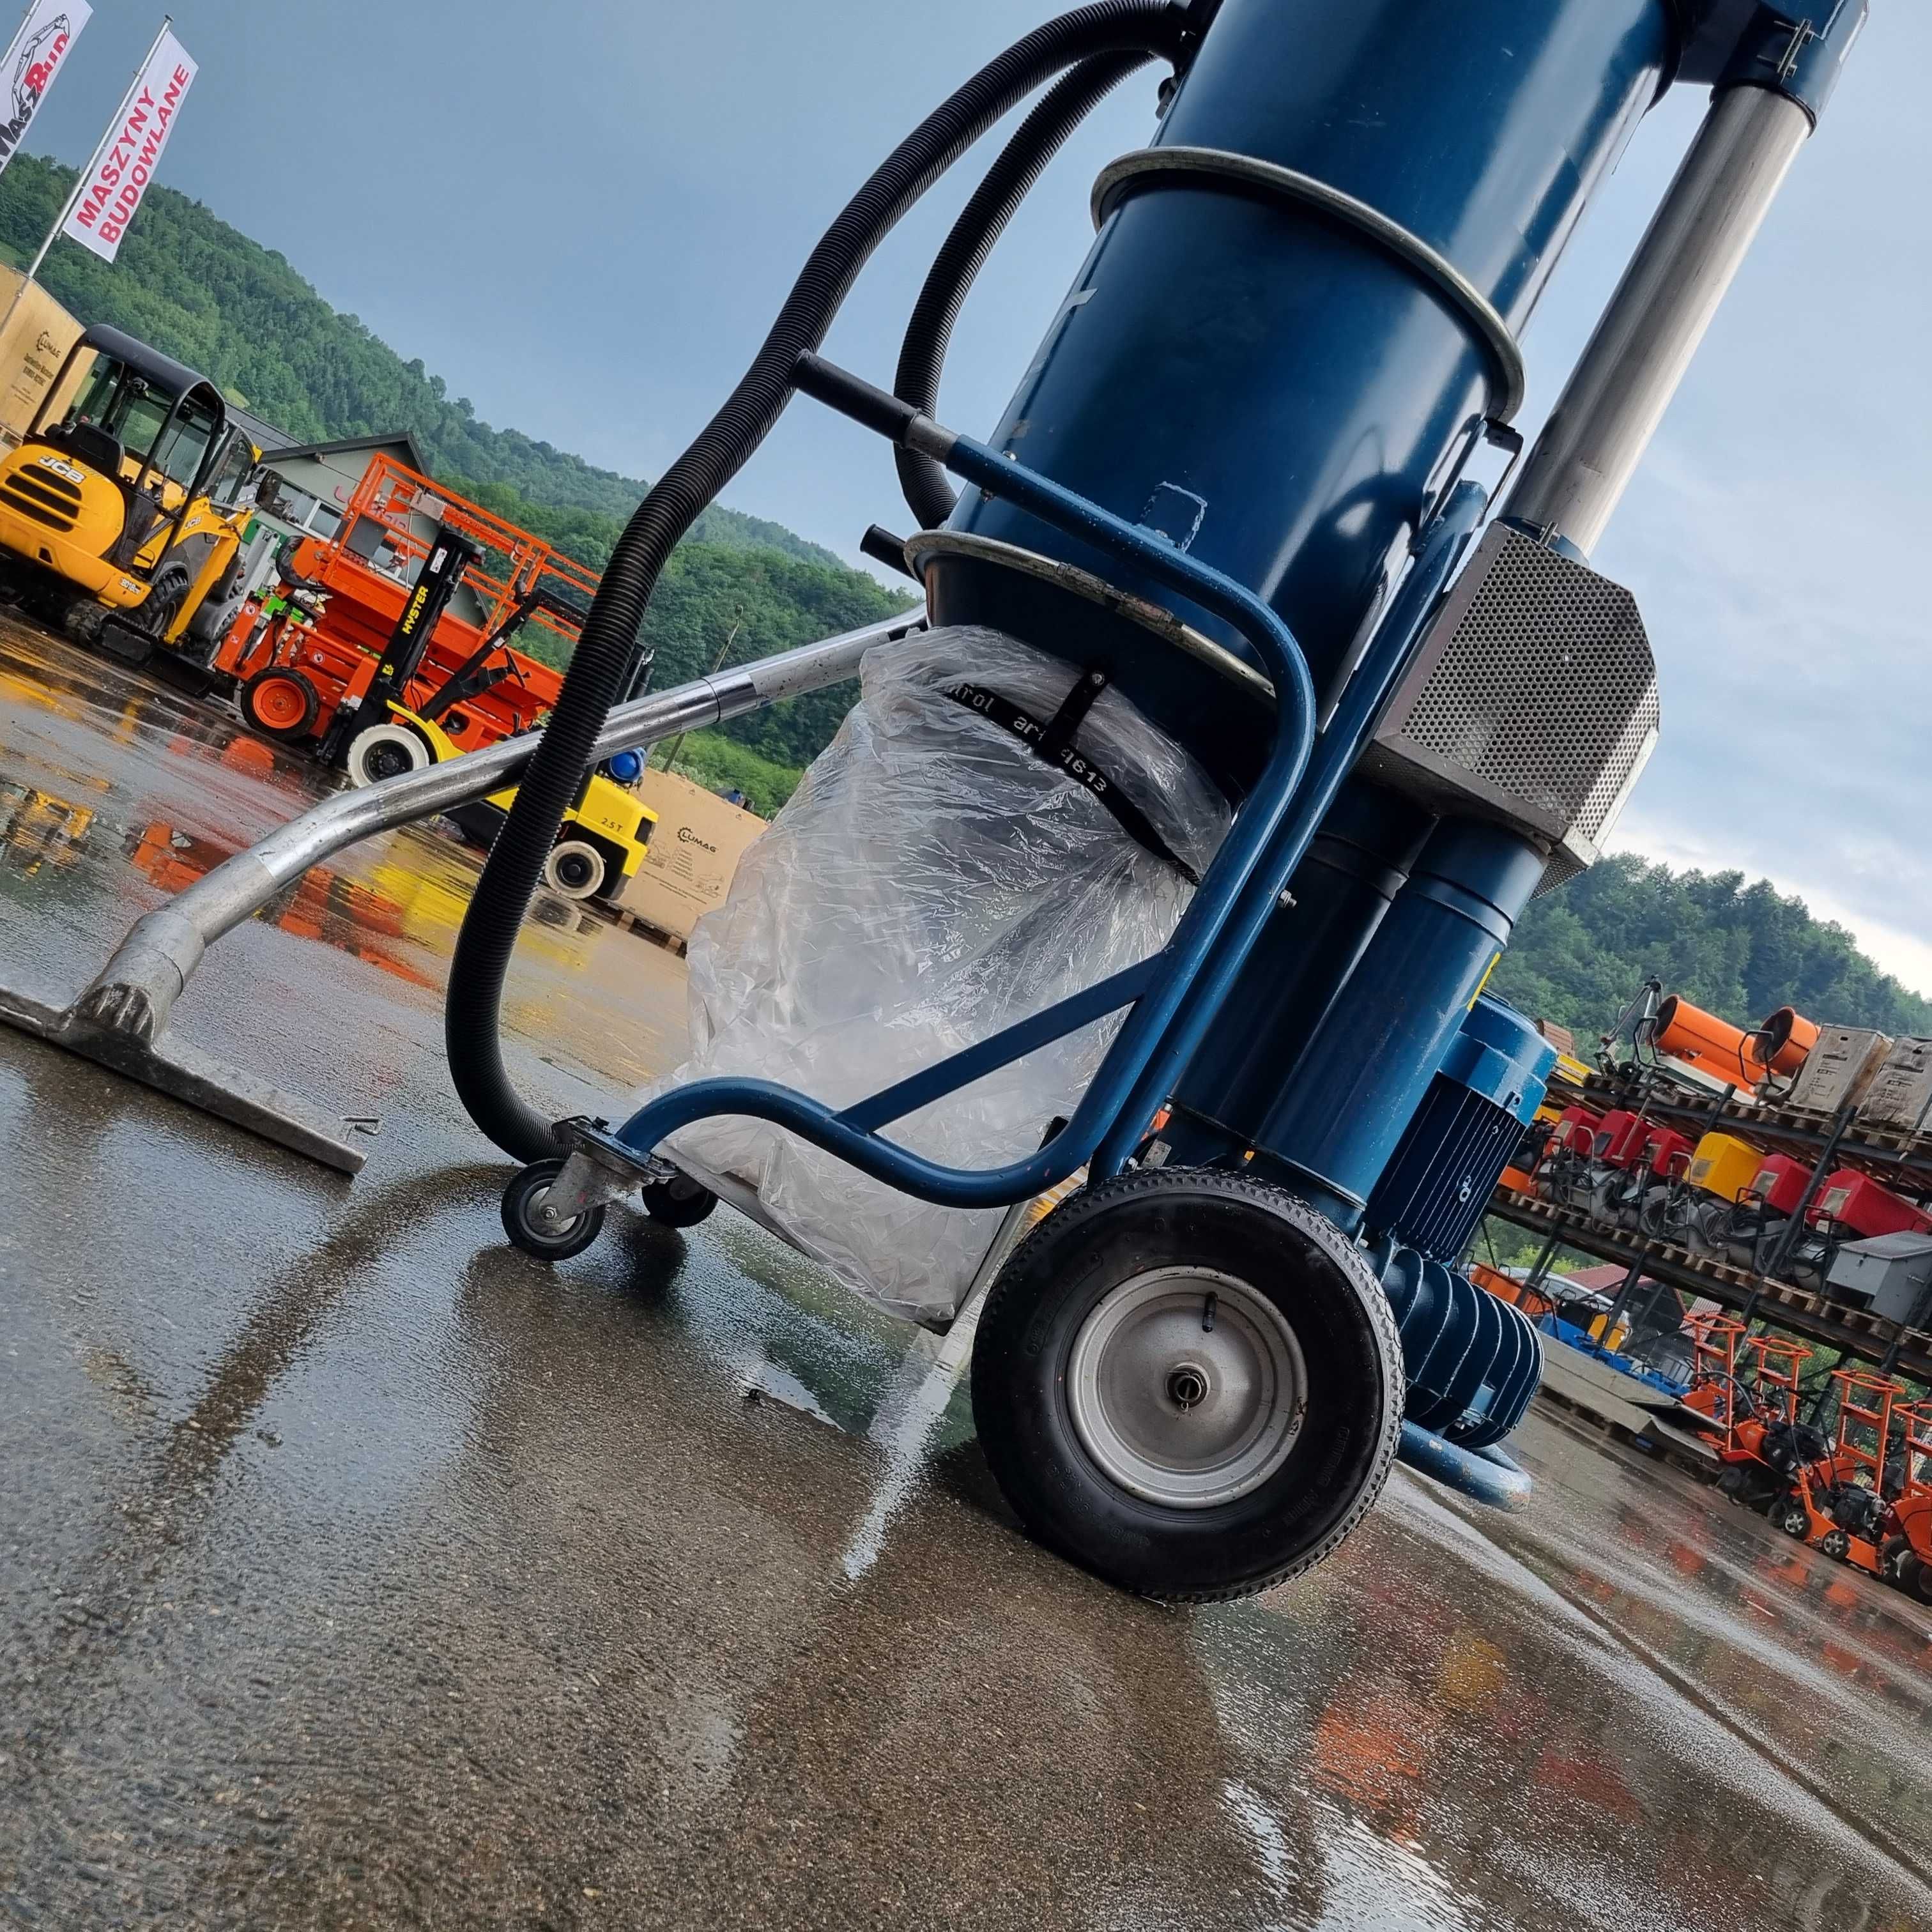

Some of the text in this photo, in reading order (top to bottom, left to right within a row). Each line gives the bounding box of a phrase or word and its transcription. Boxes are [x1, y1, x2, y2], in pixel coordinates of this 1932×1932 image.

[76, 86, 155, 229] MASZYNY
[98, 64, 190, 244] BUDOWLANE
[38, 455, 86, 484] JCB
[402, 585, 428, 634] HYSTER
[601, 817, 624, 832] 2.5 T
[682, 831, 716, 853] LUMAG
